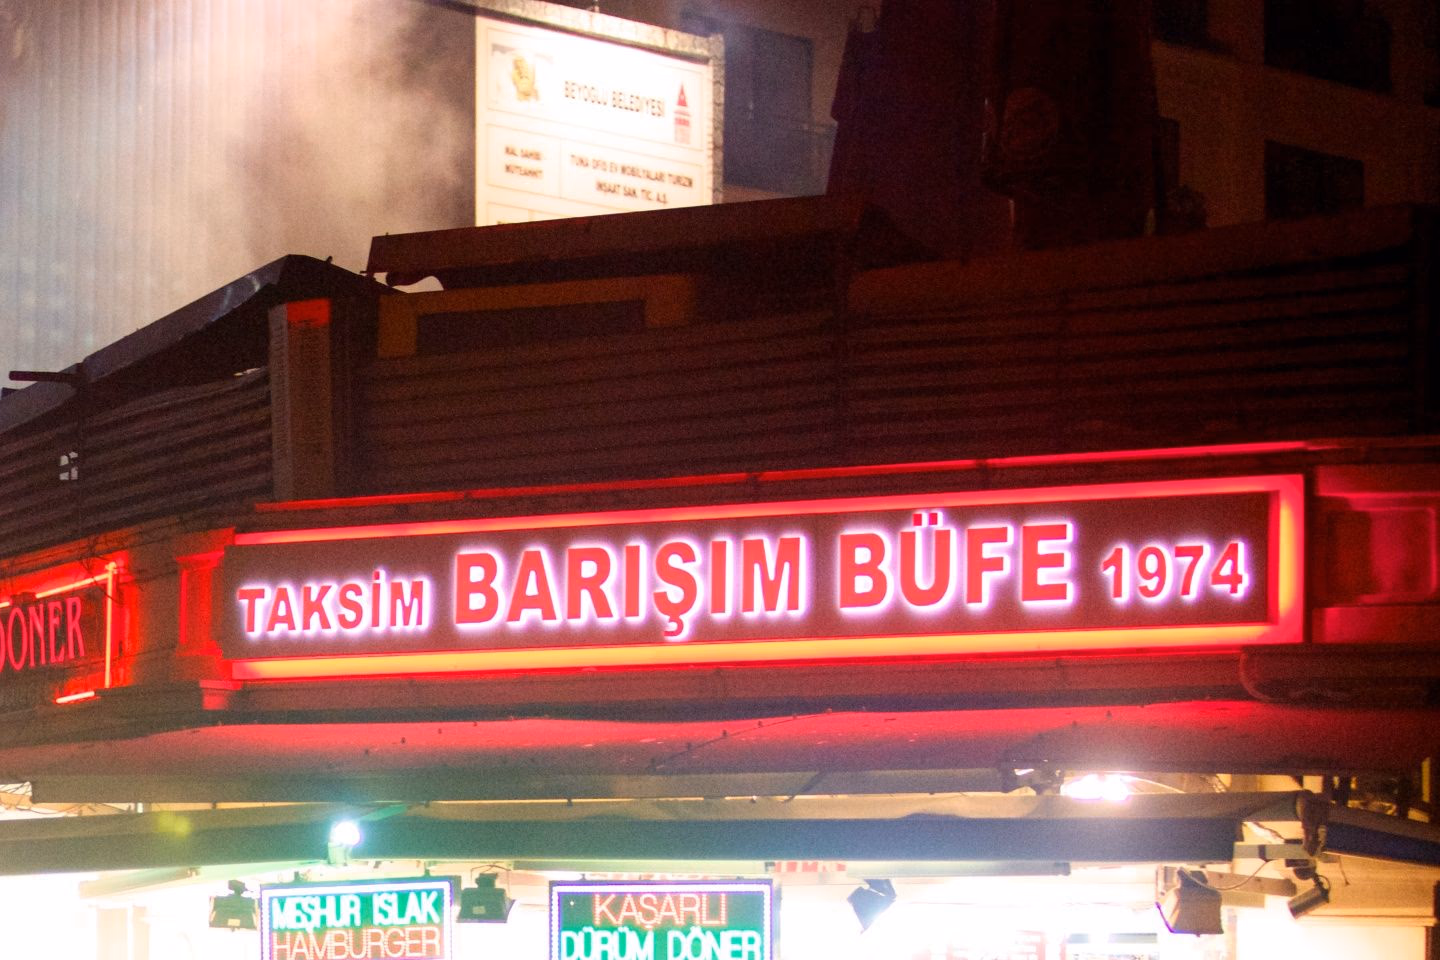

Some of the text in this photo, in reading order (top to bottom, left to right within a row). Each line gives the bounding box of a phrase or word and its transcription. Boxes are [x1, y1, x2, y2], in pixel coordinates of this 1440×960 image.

[237, 511, 1248, 639] TAKSİM BARIŞIM BÜFE 1974
[593, 892, 728, 931] KAŞARLI
